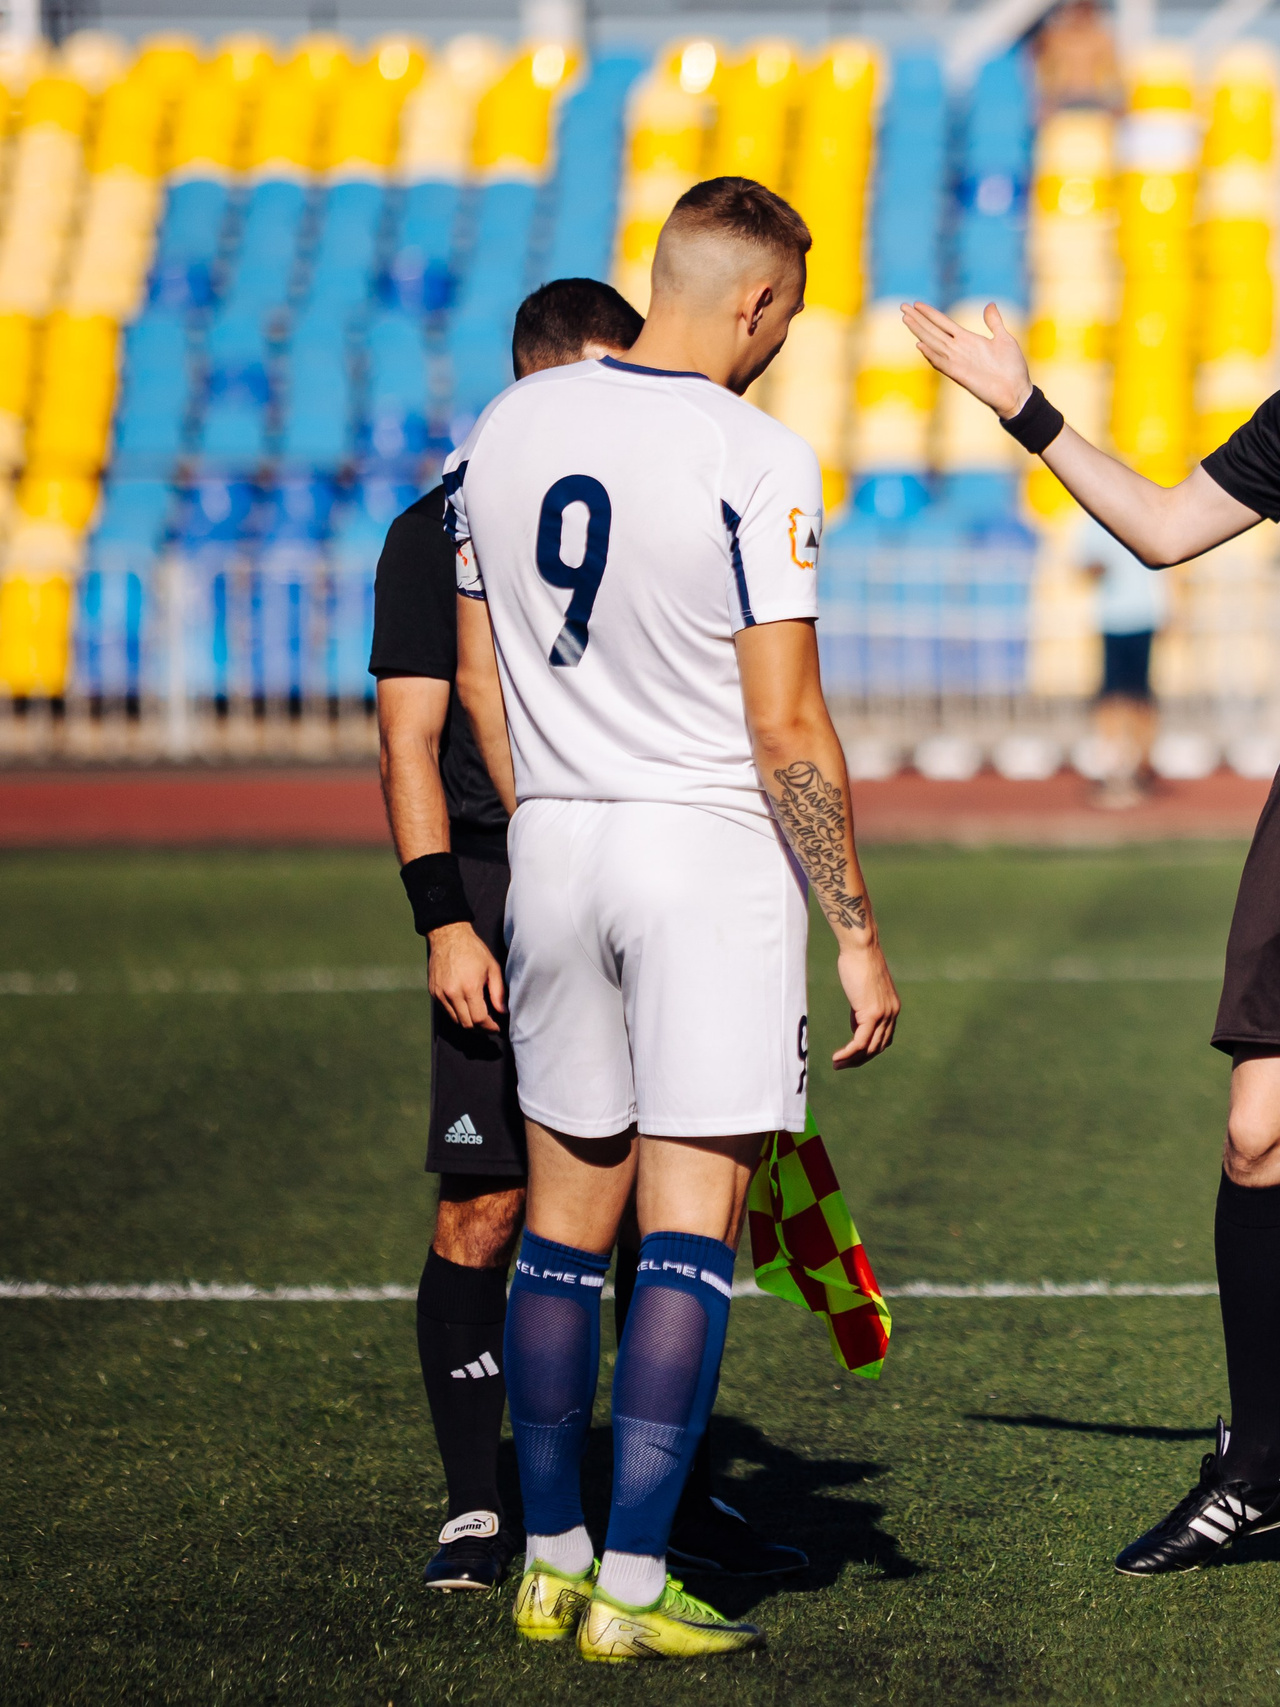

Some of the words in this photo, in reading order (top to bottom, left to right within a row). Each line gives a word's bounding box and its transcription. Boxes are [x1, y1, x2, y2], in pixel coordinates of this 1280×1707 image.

[536, 474, 612, 668] 9
[444, 1132, 483, 1145] adidas
[637, 1259, 697, 1279] ELME
